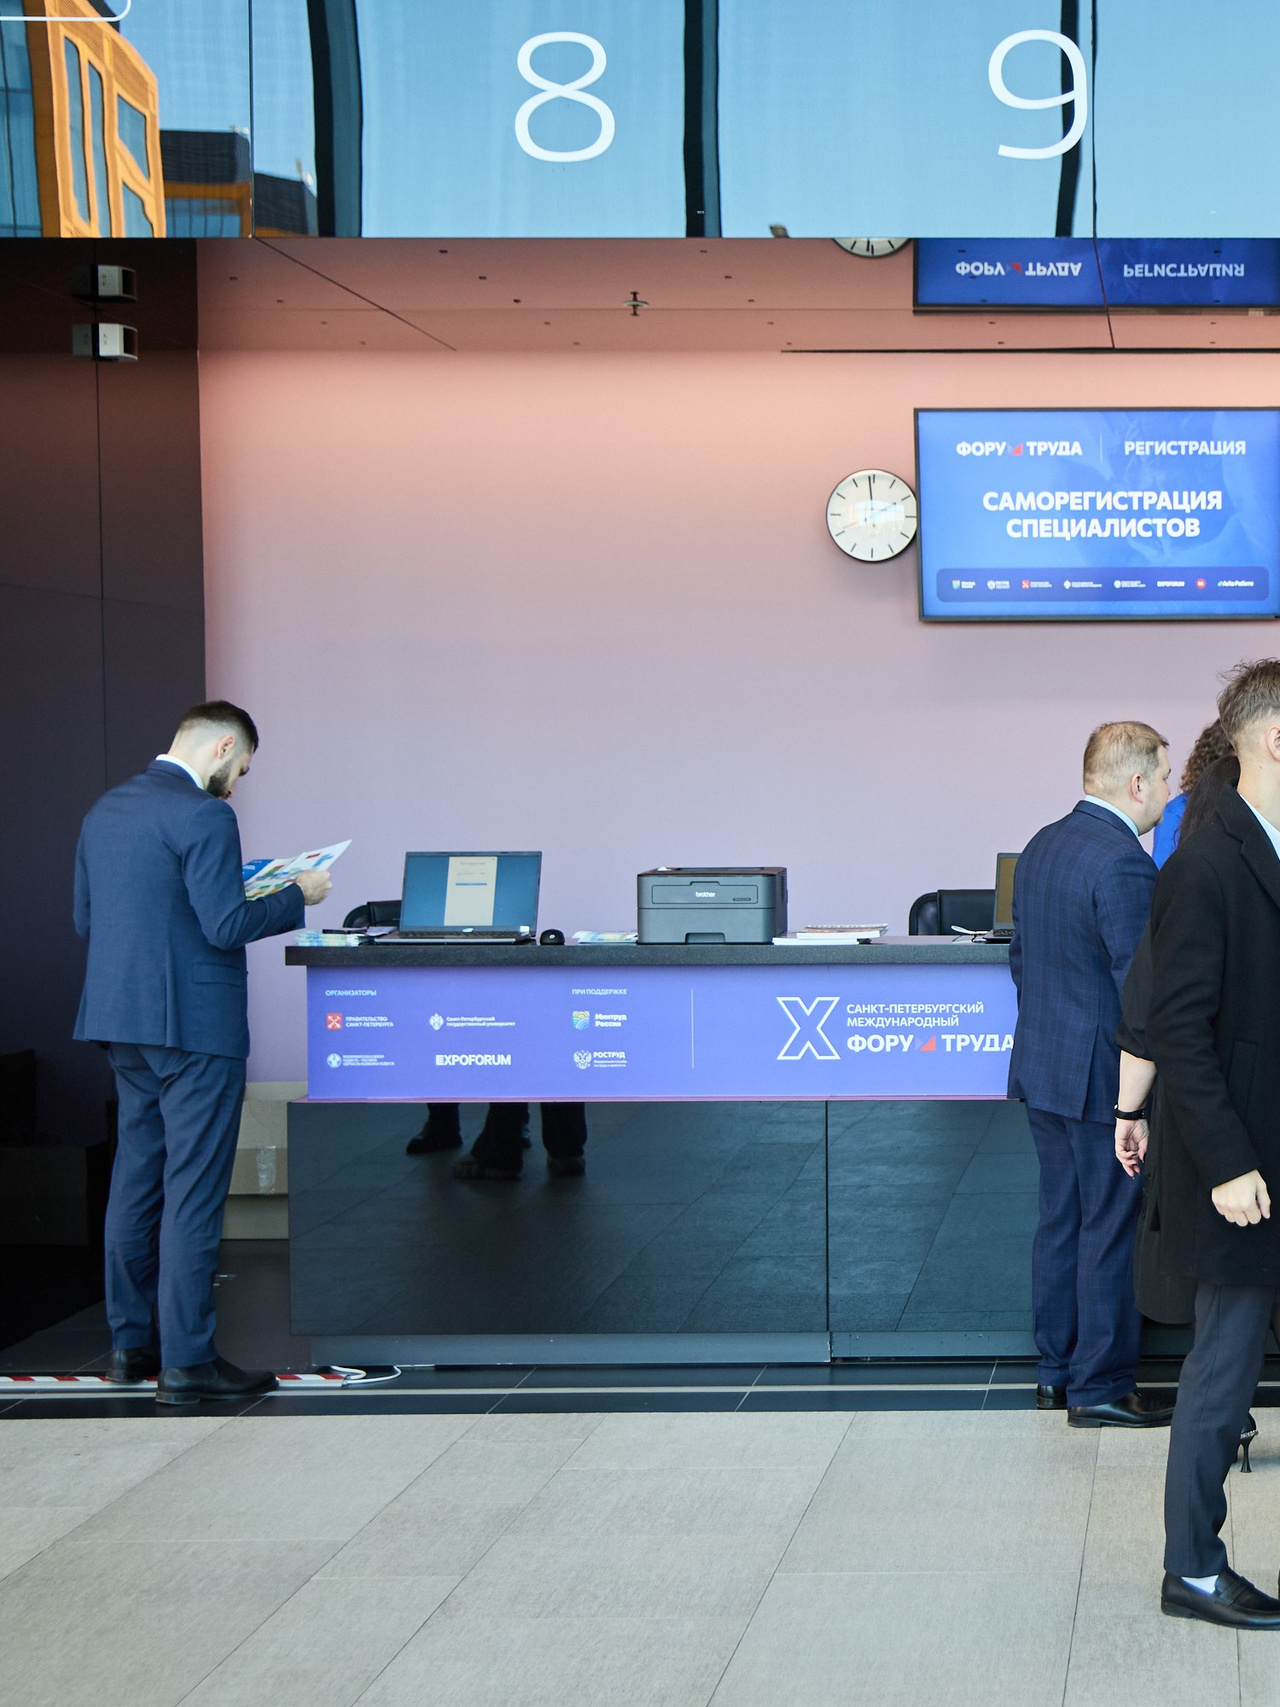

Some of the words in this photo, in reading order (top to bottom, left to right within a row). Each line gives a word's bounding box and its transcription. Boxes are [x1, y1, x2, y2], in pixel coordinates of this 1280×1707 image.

[515, 31, 616, 163] 8
[988, 29, 1089, 160] 9
[1026, 441, 1083, 457] ТРУДА
[1124, 440, 1246, 458] РЕГИСТРАЦИЯ
[982, 490, 1223, 513] САМОРЕГИСТРАЦИЯ
[1006, 518, 1201, 541] СПЕЦИАЛИСТОВ
[586, 988, 627, 996] ПОДДЕРЖКЕ
[846, 1001, 984, 1014] САНКТ-ПЕТЕРБУРГСКИЙ
[595, 1013, 627, 1021] Минтруд
[846, 1014, 960, 1029] МЕЖДУНАРОДНЫЙ
[941, 1034, 1014, 1053] ТРУДА
[435, 1055, 511, 1066] EXPOFORUM
[593, 1051, 626, 1059] РОСТРУД
